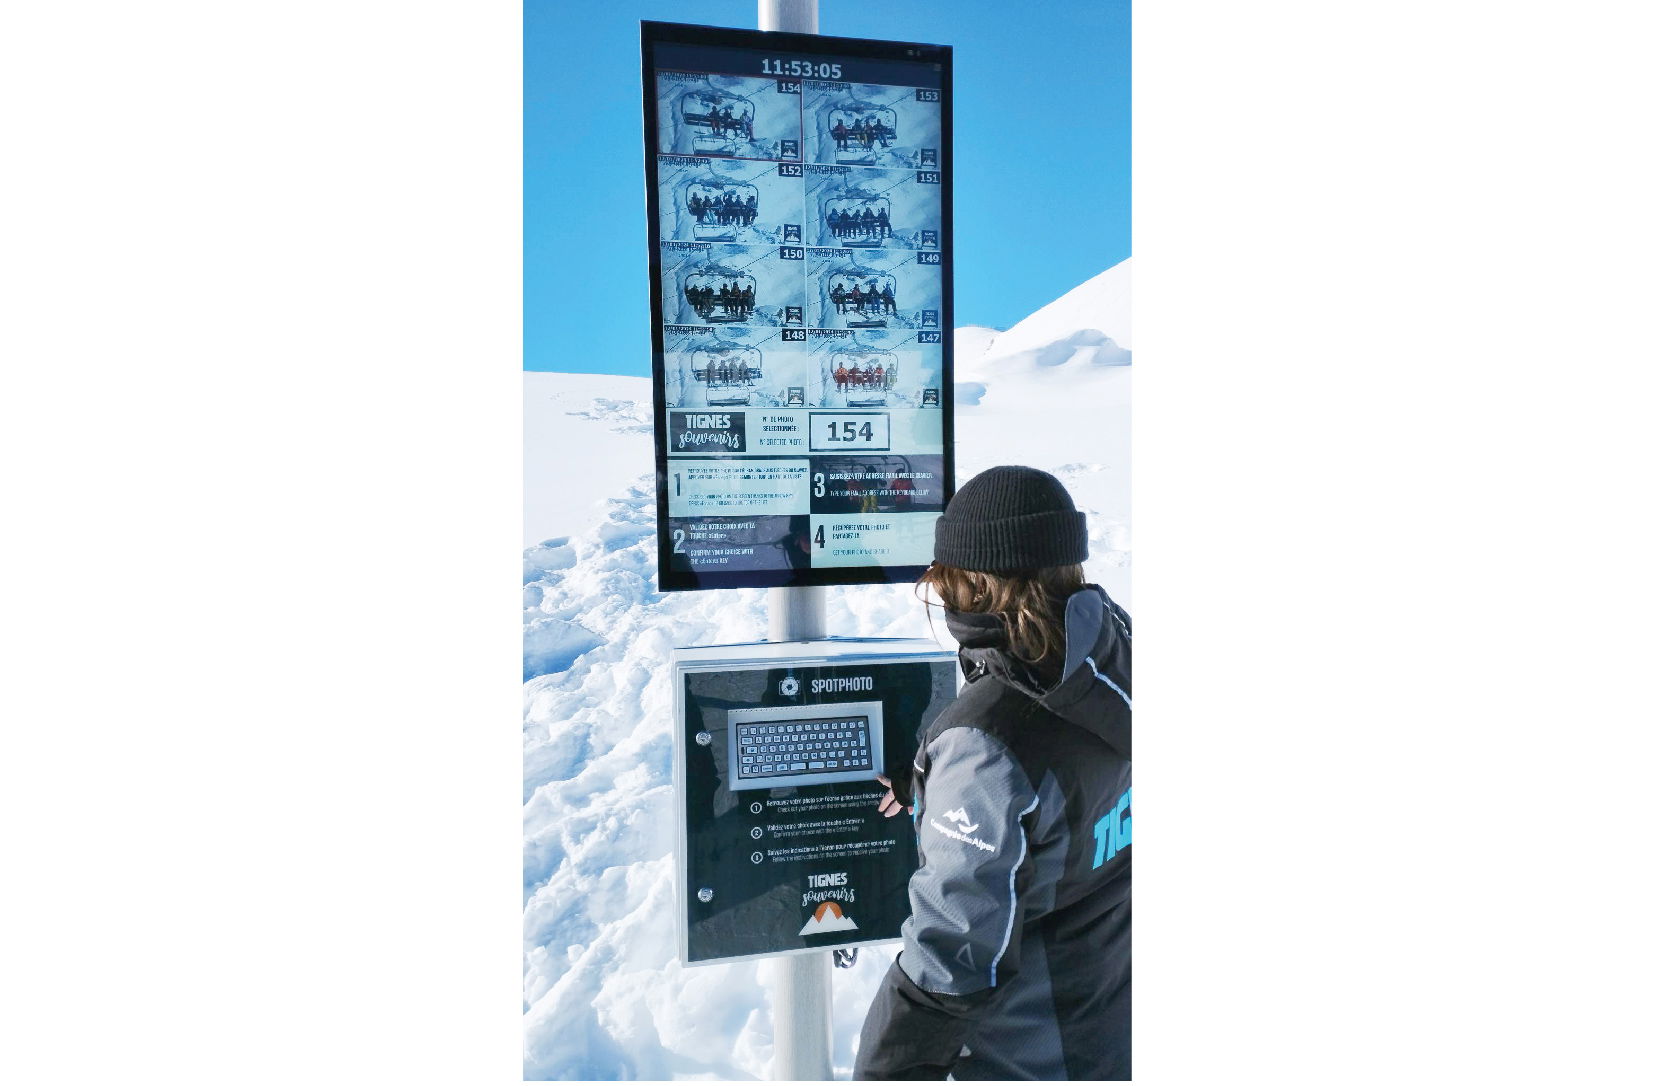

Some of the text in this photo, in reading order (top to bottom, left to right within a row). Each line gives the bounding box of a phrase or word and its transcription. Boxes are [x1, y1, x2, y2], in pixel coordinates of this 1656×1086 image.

[761, 58, 842, 79] 11:53:05
[781, 83, 800, 93] 154
[919, 91, 938, 100] 153
[781, 165, 802, 175] 152
[920, 173, 938, 183] 151
[783, 249, 803, 259] 150
[920, 254, 938, 263] 149
[785, 330, 805, 340] 148
[921, 333, 939, 342] 147
[685, 414, 731, 429] TIGNES
[678, 430, 740, 449] souvenirs
[827, 421, 874, 442] 154
[673, 472, 681, 497] 1
[813, 472, 826, 498] 3
[673, 528, 686, 554] 2
[814, 524, 826, 549] 4
[811, 676, 873, 694] SPOTPHOTO
[1092, 786, 1132, 870] TIG
[971, 837, 996, 853] Alpes
[807, 872, 848, 888] TIGNES
[801, 886, 855, 907] souvenirs
